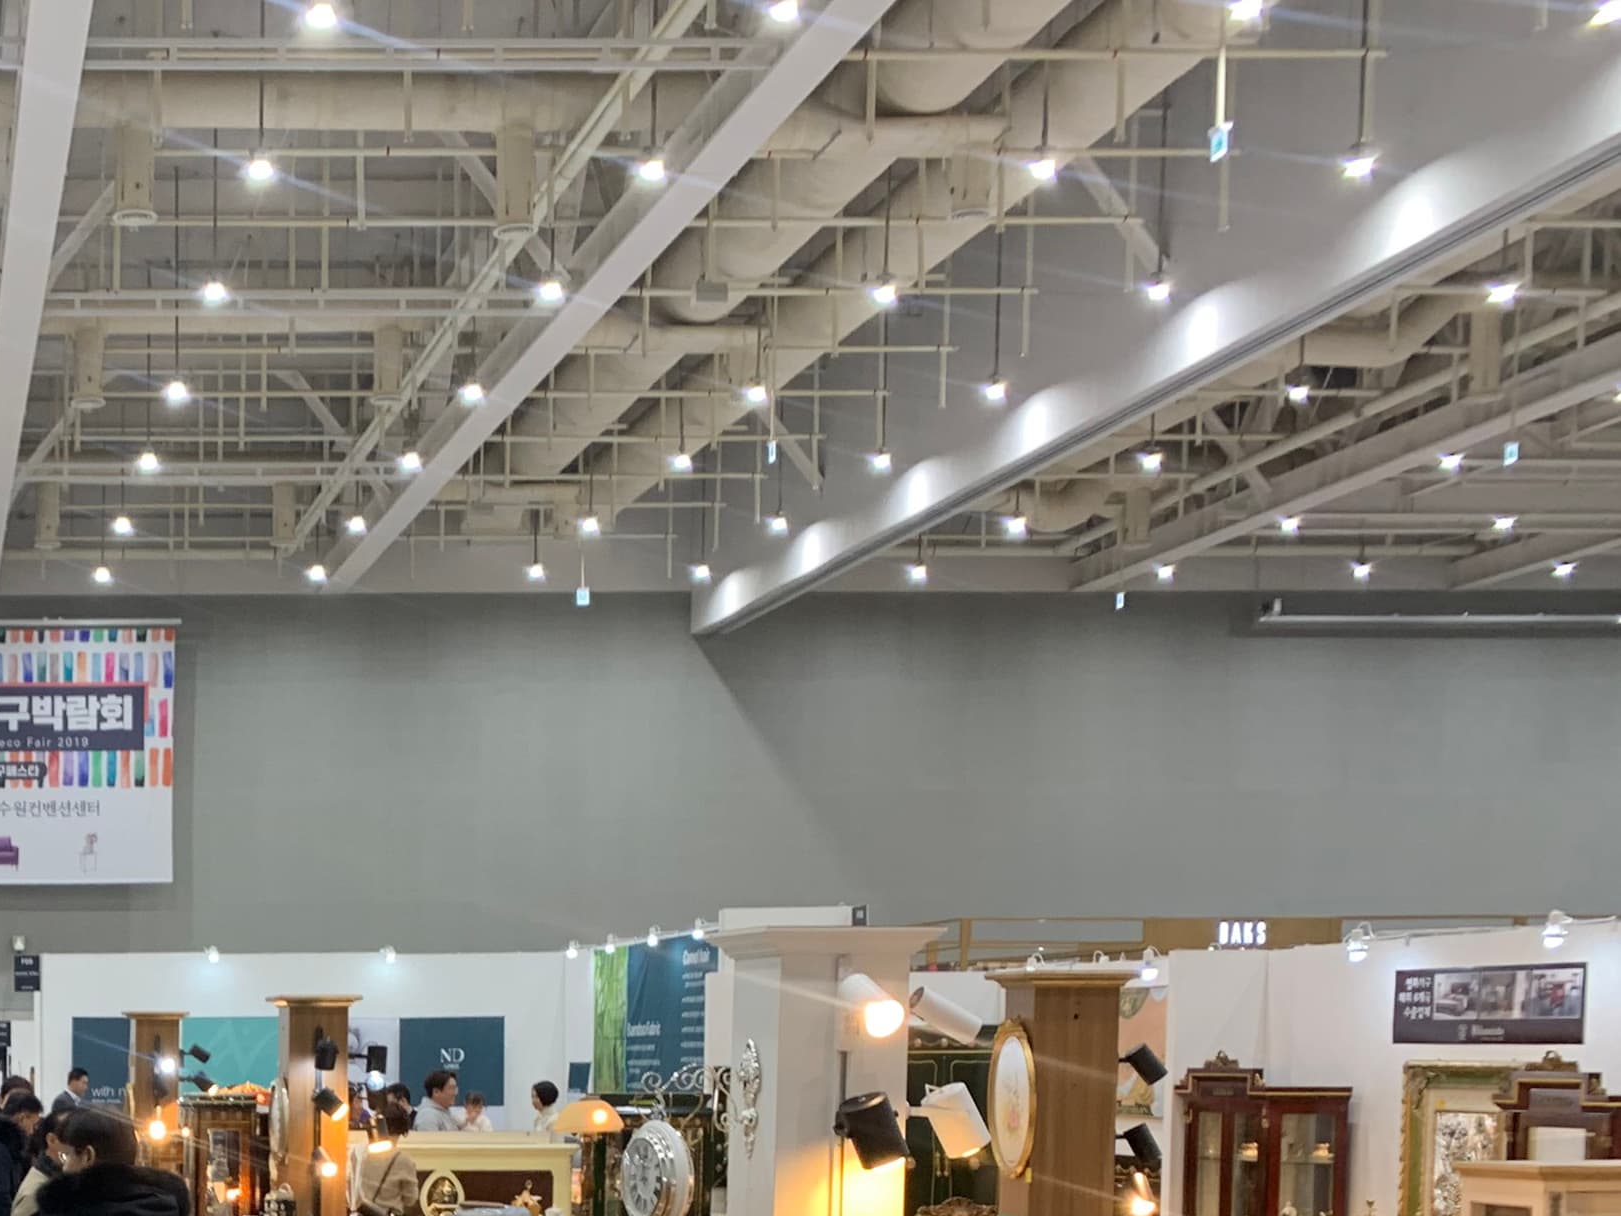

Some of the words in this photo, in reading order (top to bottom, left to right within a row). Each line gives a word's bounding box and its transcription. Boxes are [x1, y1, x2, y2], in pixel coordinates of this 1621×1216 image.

[26, 736, 51, 748] Fair
[57, 736, 89, 748] 2019
[440, 1047, 466, 1064] ND
